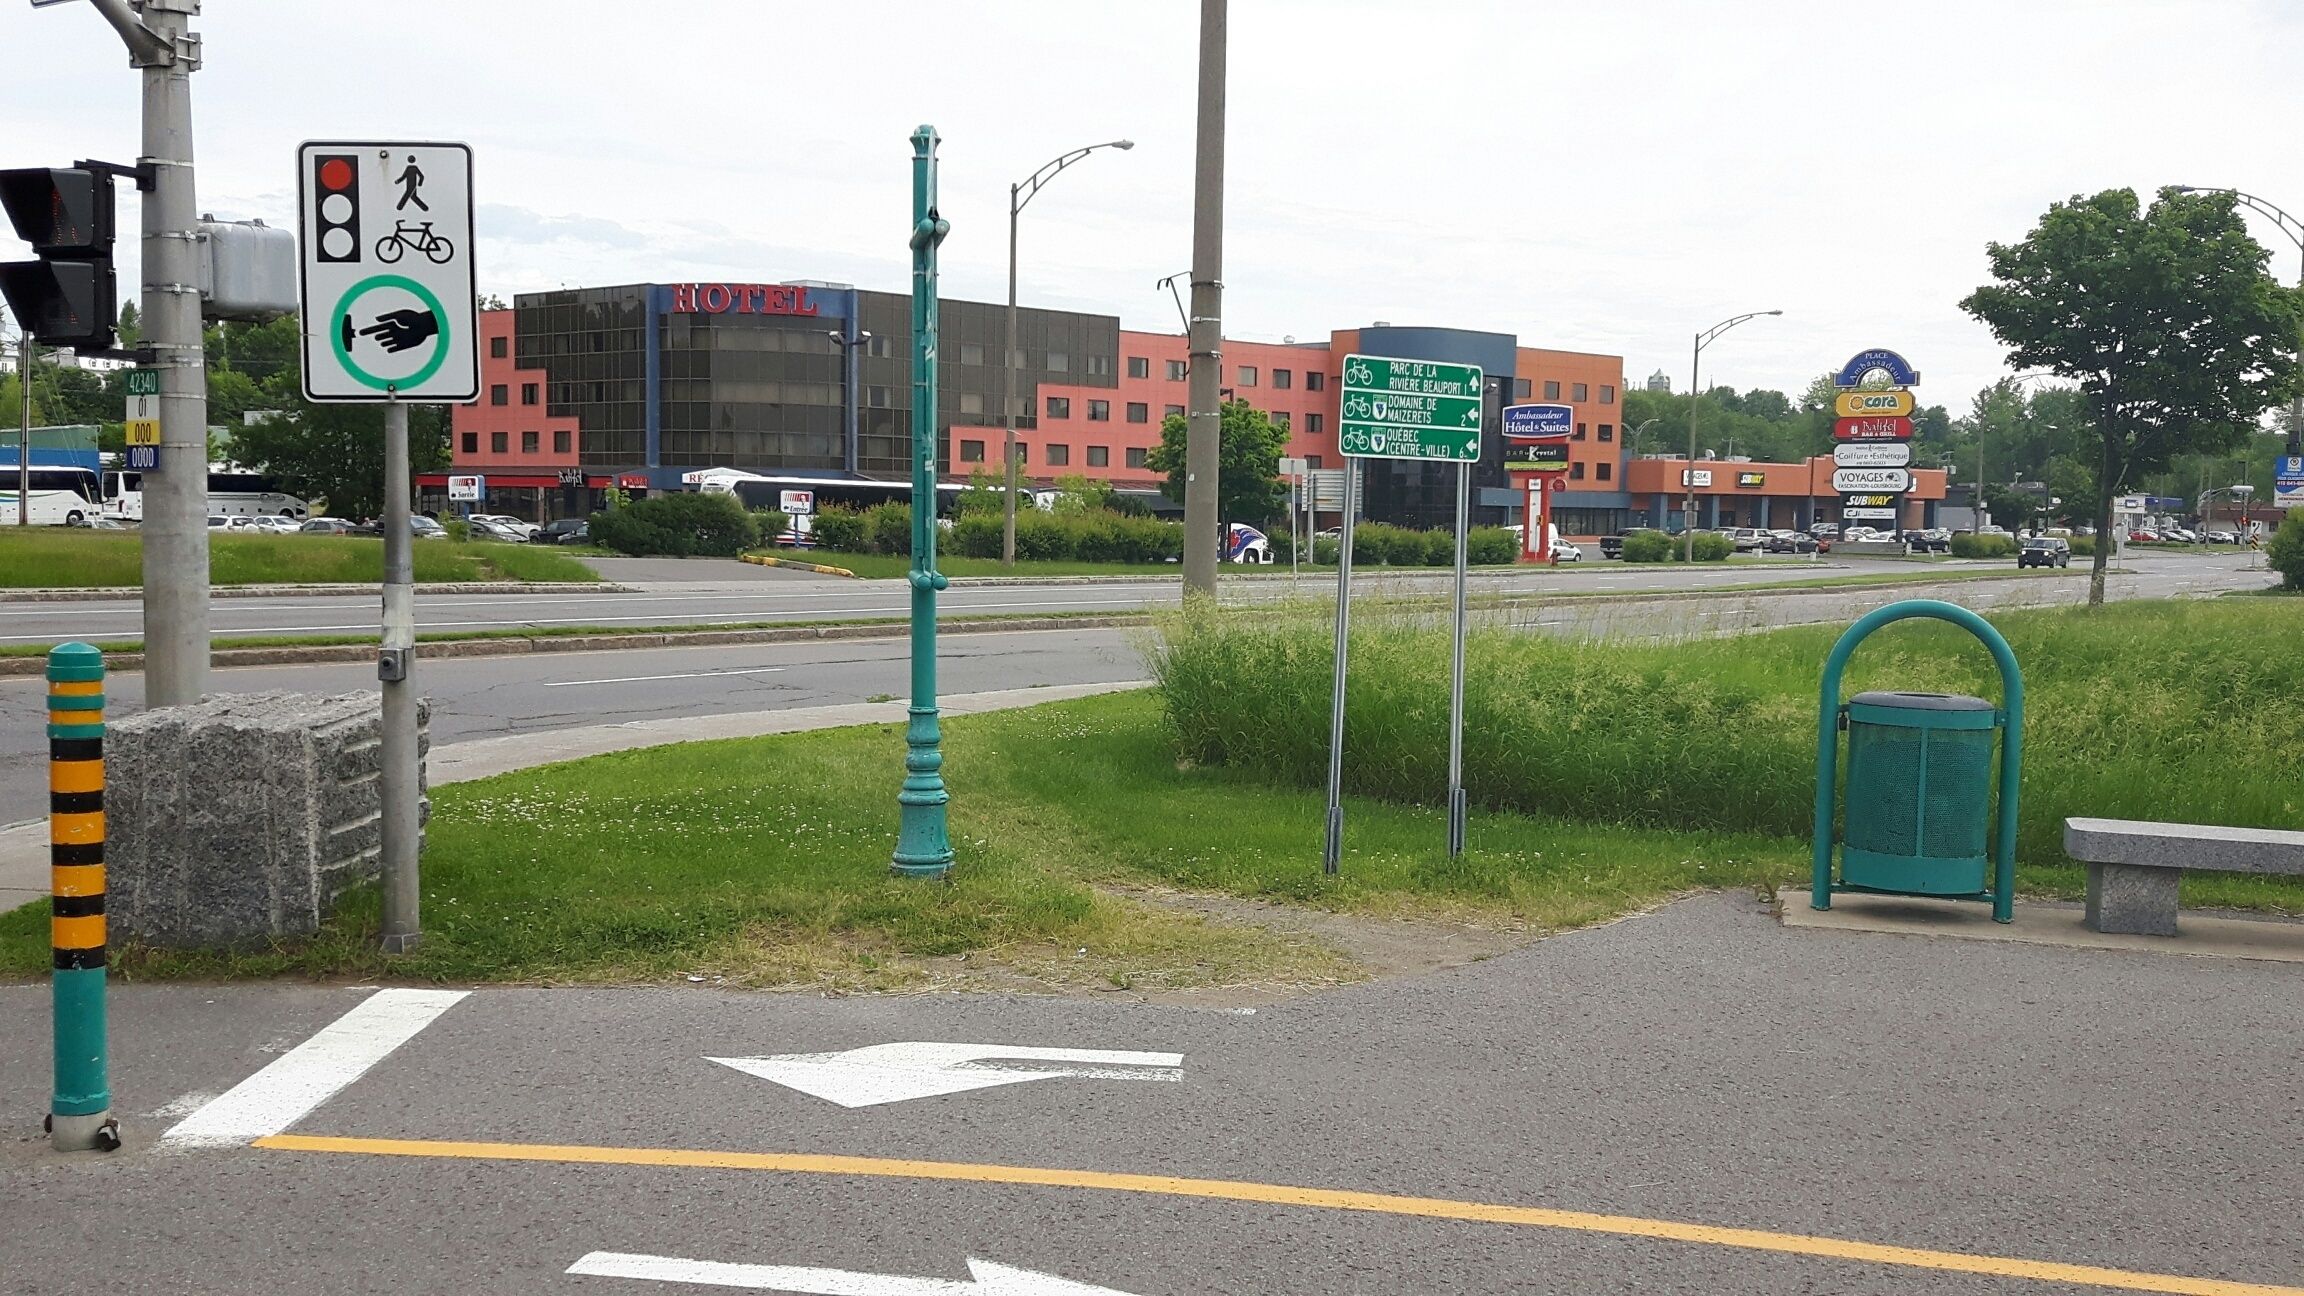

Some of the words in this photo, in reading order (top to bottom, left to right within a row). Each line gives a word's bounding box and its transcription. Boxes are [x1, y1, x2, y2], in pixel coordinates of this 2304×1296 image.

[672, 283, 817, 316] HOTEL
[1390, 362, 1410, 376] PARC
[1413, 364, 1424, 377] DE
[1426, 365, 1437, 378] LA
[1849, 359, 1901, 382] Ambassadeur
[129, 373, 156, 393] 42340
[1389, 376, 1420, 392] RIVIÈRE
[1423, 380, 1461, 395] BEAUPORT
[138, 397, 147, 417] 01
[1388, 395, 1424, 410] DOMAINE
[1426, 398, 1437, 411] DE
[1864, 395, 1898, 408] cora
[1387, 409, 1432, 424] MAIZERETS
[1460, 414, 1466, 427] 2
[1512, 410, 1563, 420] Ambassadeur
[135, 423, 151, 442] 000
[1386, 427, 1419, 442] QUÉBEC
[1505, 421, 1534, 433] Hôtel
[1540, 421, 1569, 433] Suites
[1386, 441, 1451, 458] (CENTRE-VILLE)
[1840, 472, 1884, 482] VOYAGES
[1846, 495, 1894, 506] SUBWAY
